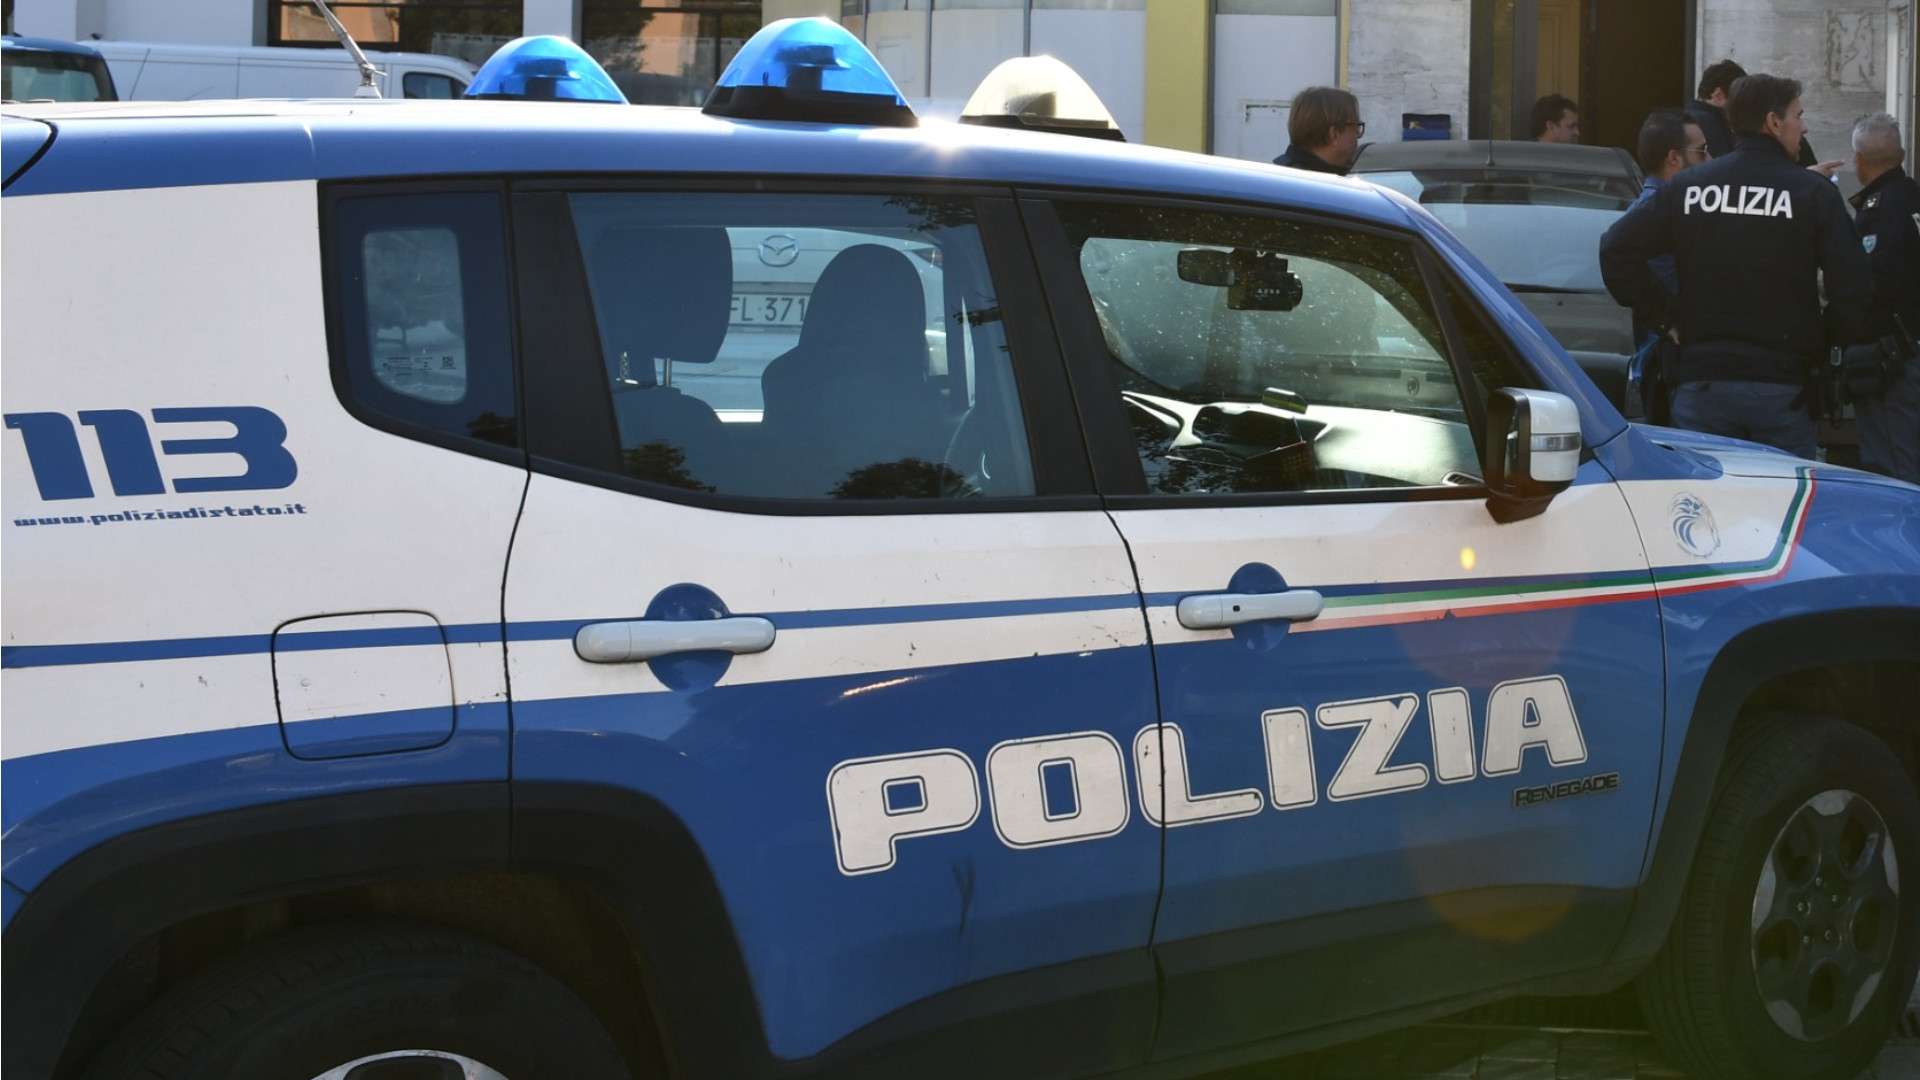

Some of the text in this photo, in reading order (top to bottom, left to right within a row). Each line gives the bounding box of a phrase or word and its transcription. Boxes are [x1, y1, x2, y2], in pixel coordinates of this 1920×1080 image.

[1684, 184, 1793, 219] POLIZIA
[3, 406, 298, 501] 113
[14, 503, 308, 527] www.poliziadistato.it
[827, 674, 1587, 876] POLIZIA
[1513, 772, 1620, 808] RENEGADE
